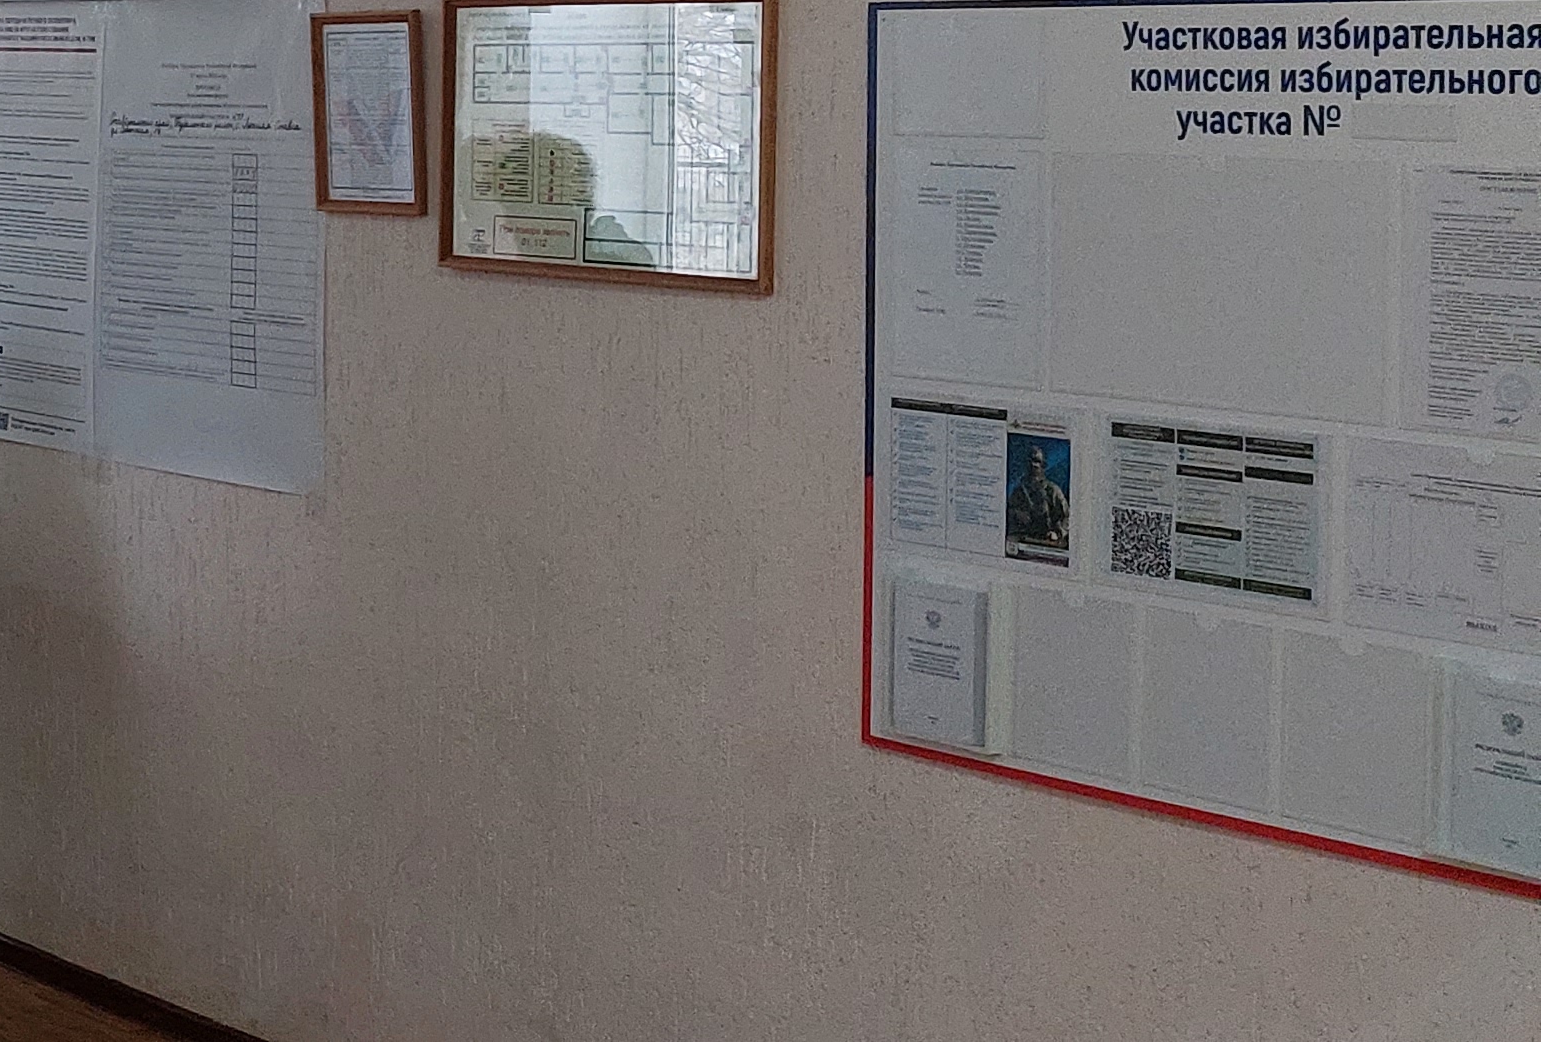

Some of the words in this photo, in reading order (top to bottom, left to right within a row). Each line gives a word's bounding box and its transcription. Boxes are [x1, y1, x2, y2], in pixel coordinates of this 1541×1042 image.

[1123, 20, 1287, 51] Участковая
[1297, 17, 1541, 56] избирательная
[1130, 67, 1271, 93] комиссия
[1280, 61, 1541, 100] избирательного
[1176, 108, 1292, 141] участка
[1303, 105, 1342, 136] №
